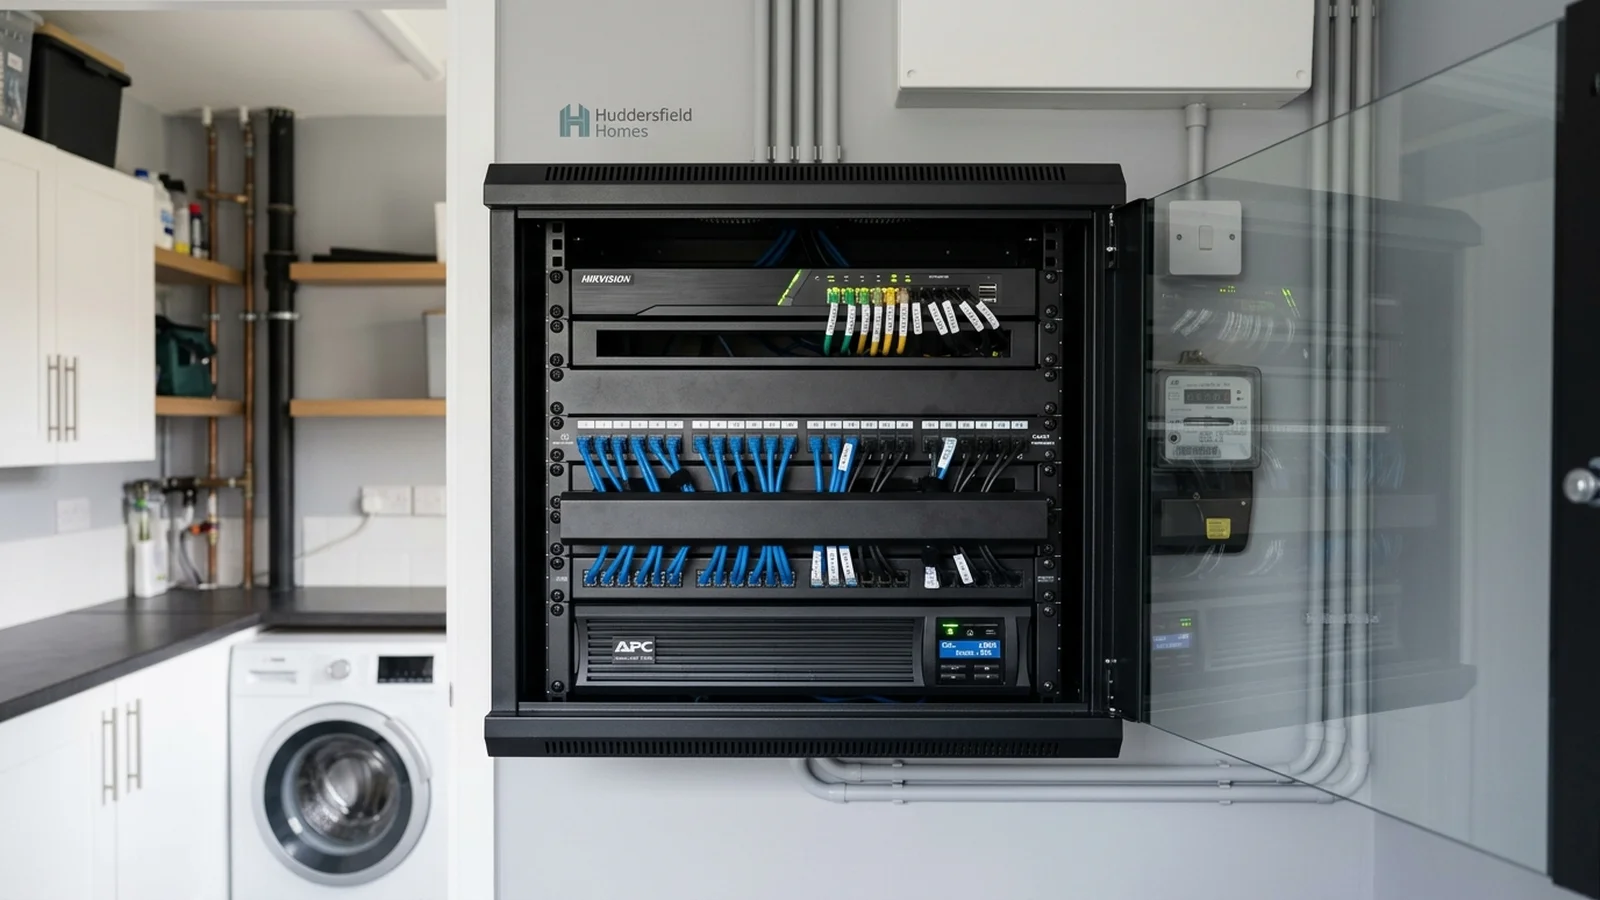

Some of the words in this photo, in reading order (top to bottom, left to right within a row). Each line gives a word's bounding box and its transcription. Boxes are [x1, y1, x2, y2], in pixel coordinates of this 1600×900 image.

[596, 107, 693, 122] Huddersfield
[596, 124, 649, 138] Homes
[580, 274, 632, 284] HIKVISION
[614, 640, 653, 653] APC
